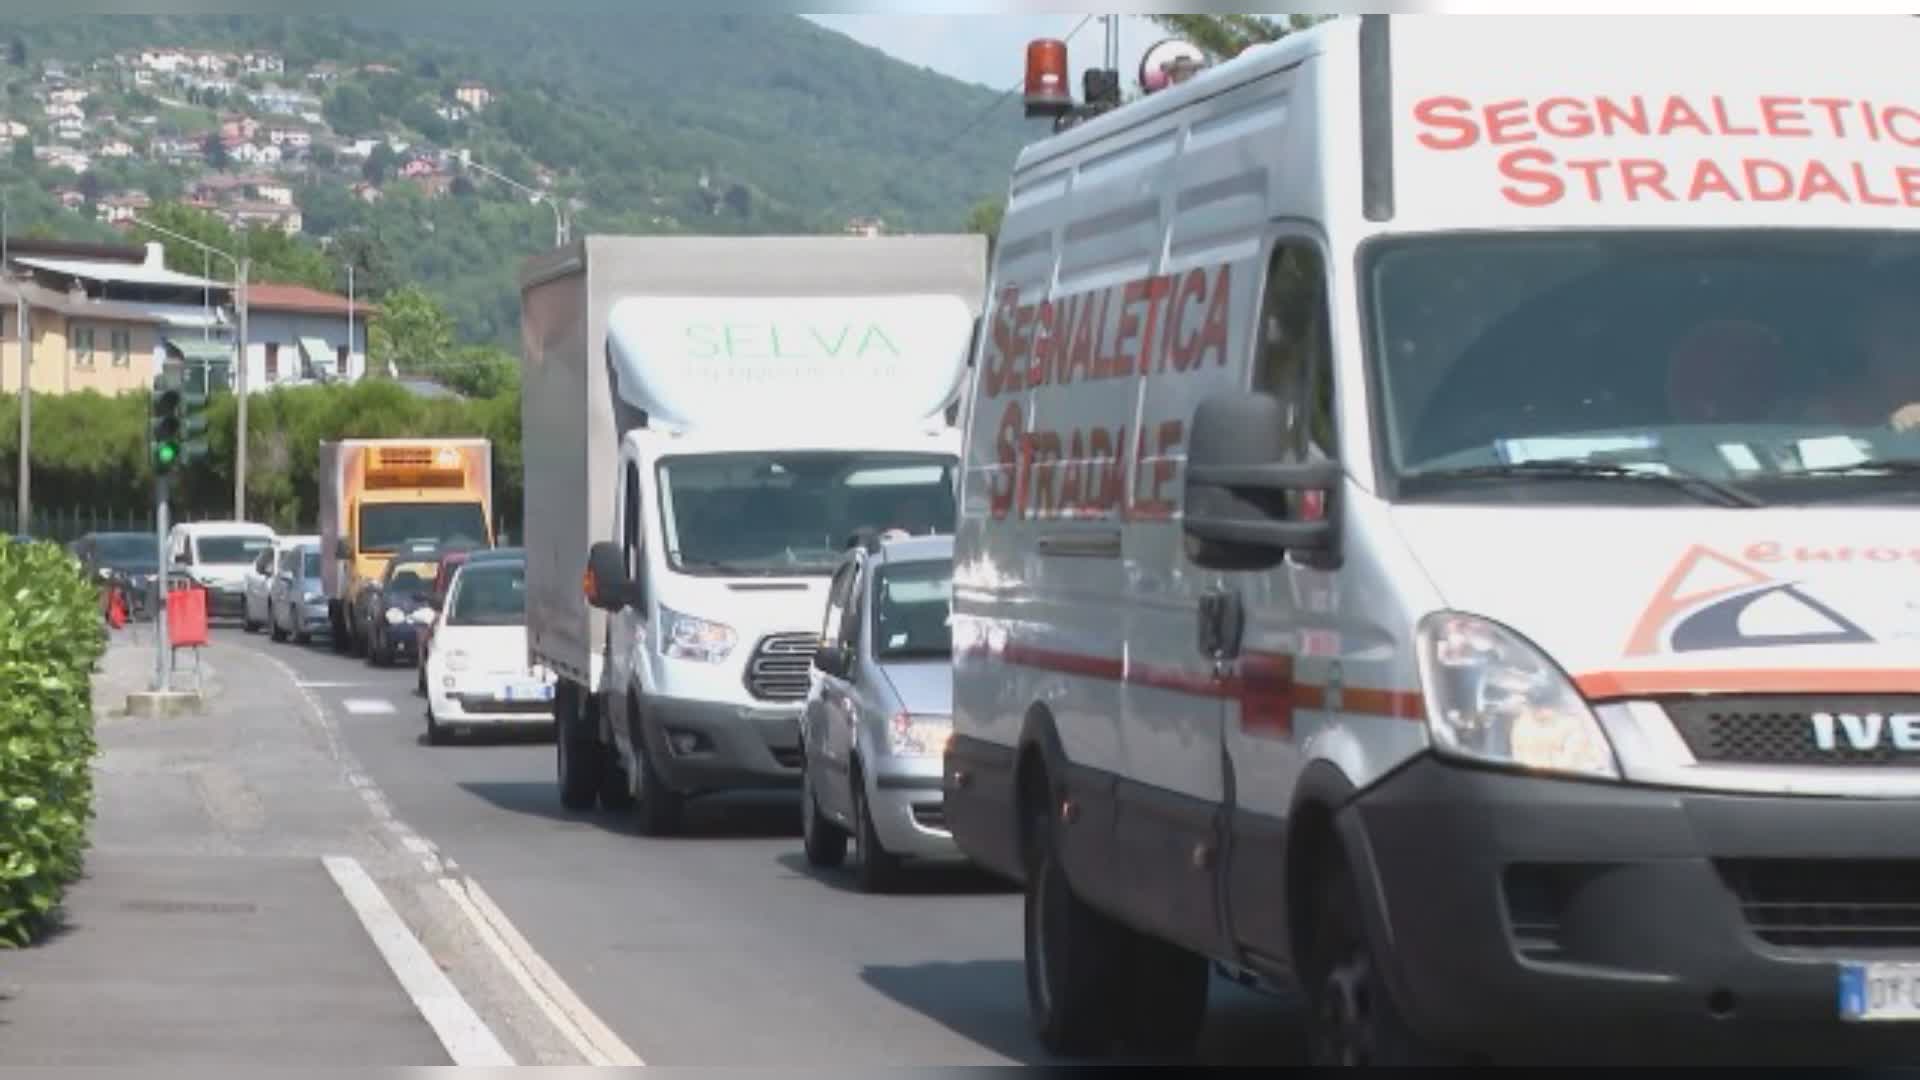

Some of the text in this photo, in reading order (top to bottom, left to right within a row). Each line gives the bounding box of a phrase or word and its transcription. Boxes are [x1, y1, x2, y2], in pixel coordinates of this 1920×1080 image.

[1498, 148, 1920, 208] STRADALE
[684, 322, 902, 358] SELVA
[985, 263, 1231, 397] SEGNALETICA
[991, 401, 1184, 520] STRADALE
[1811, 712, 1920, 750] IVE
